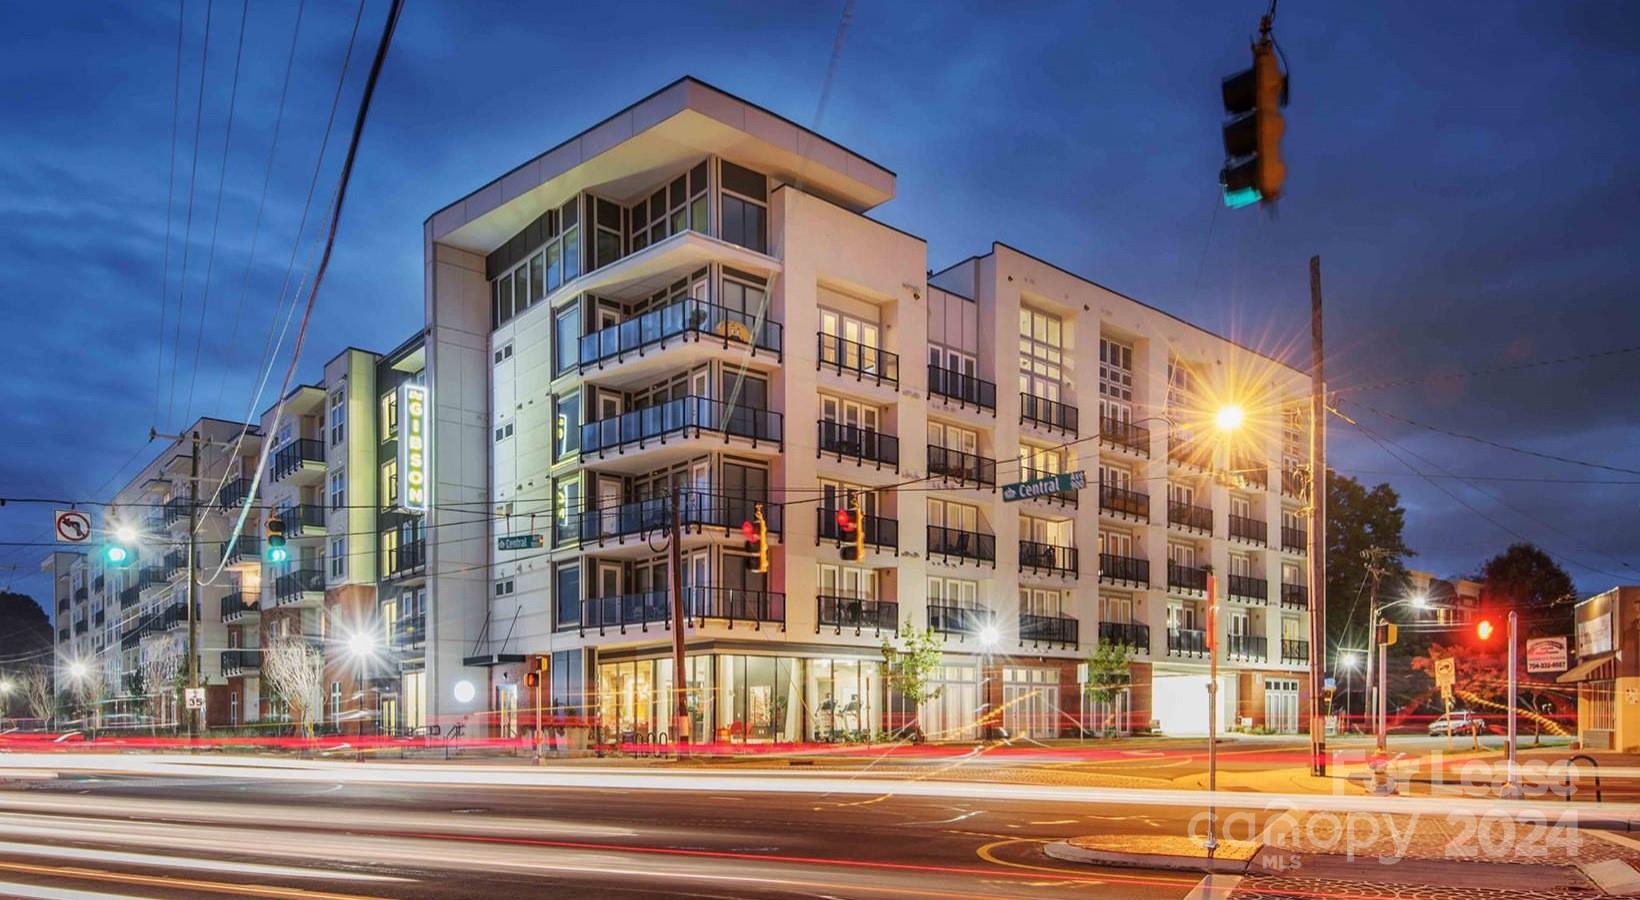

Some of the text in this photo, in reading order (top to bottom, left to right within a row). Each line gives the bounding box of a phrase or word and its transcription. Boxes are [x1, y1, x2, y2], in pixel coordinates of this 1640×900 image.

[408, 402, 423, 503] GIBSON
[1019, 478, 1060, 496] Central
[189, 698, 202, 706] 35
